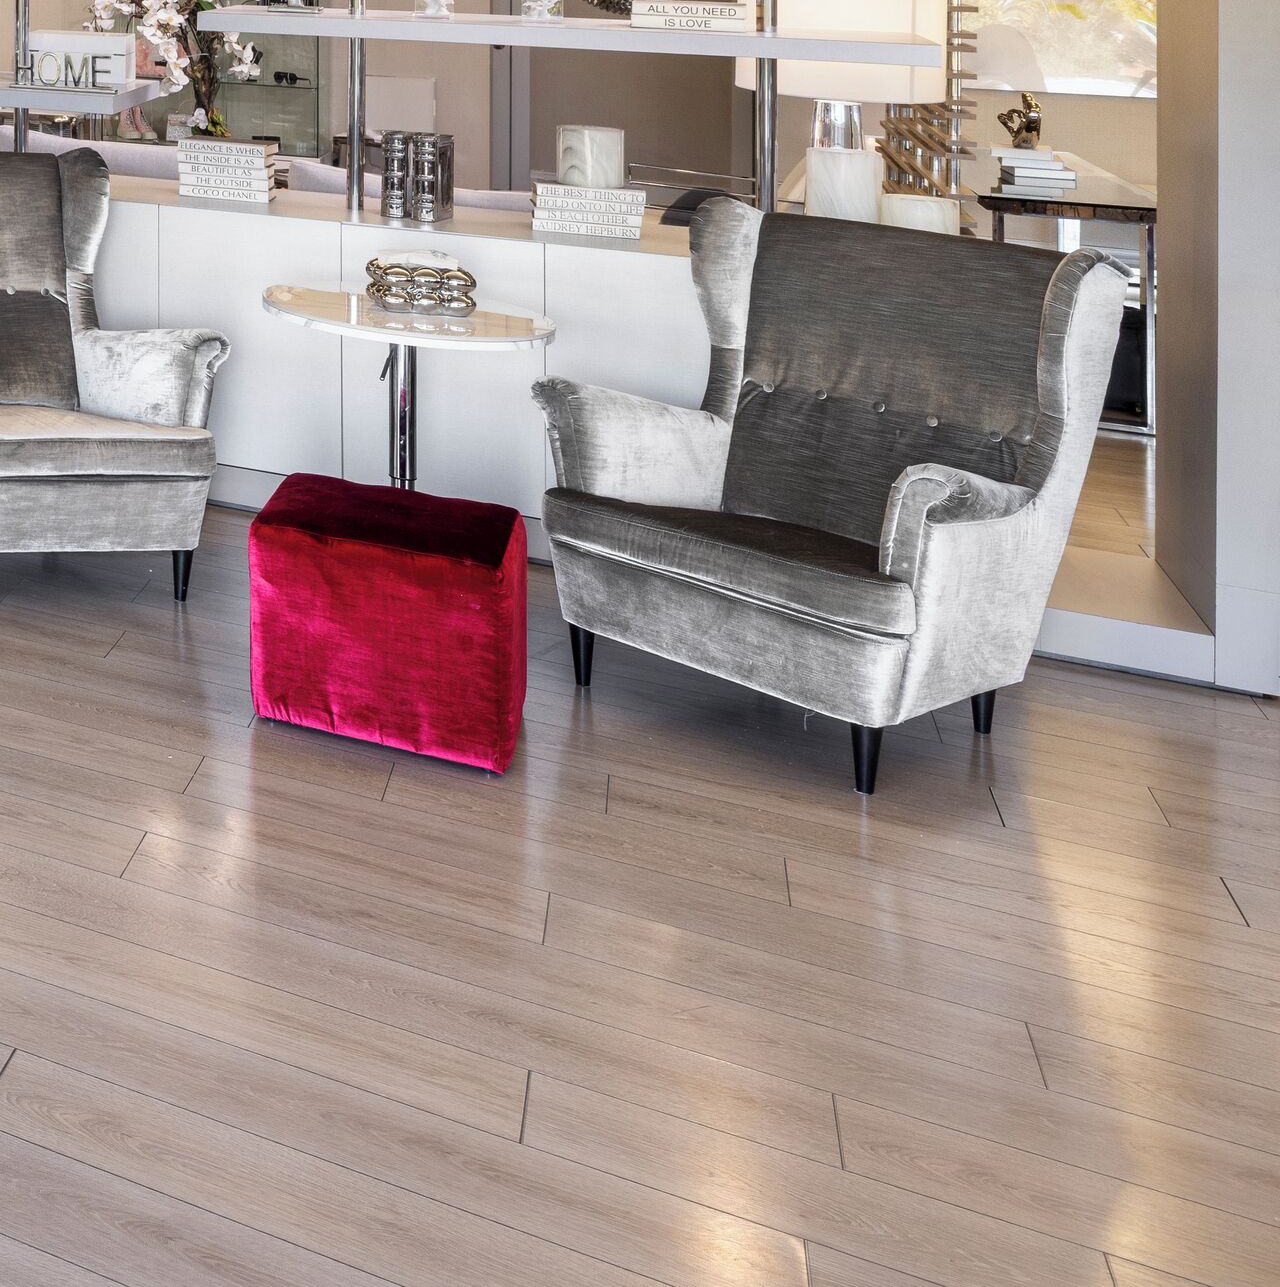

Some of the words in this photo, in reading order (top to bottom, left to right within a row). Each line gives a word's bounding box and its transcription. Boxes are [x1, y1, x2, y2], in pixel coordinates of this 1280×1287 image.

[647, 4, 669, 14] ALL
[672, 5, 699, 15] YOU
[703, 7, 737, 17] NEED
[664, 18, 677, 27] IS
[679, 19, 712, 28] LOVE
[15, 52, 112, 89] HOME
[180, 142, 224, 153] ELEGANCE
[226, 146, 233, 154] IS
[235, 147, 263, 156] WHEN
[184, 154, 200, 162] THE
[203, 155, 231, 164] INSIDE
[244, 158, 255, 166] AS
[191, 165, 239, 176] BEAUTIFUL
[241, 169, 252, 177] AS
[195, 177, 213, 185] THE
[214, 178, 254, 188] OUTSIDE
[192, 187, 220, 197] COCO
[222, 191, 258, 200] CHANEL
[540, 186, 560, 196] THE
[563, 188, 589, 198] BEST
[593, 191, 626, 202] THING
[629, 194, 644, 203] TO
[539, 198, 569, 208] HOLD
[571, 202, 602, 211] ONTO
[604, 203, 616, 212] IN
[619, 205, 643, 215] LIFE
[547, 210, 557, 219] IS
[560, 211, 589, 221] EACH
[592, 214, 628, 225] OTHER
[535, 221, 585, 233] -AUDREY
[586, 225, 637, 238] HEPBURN
